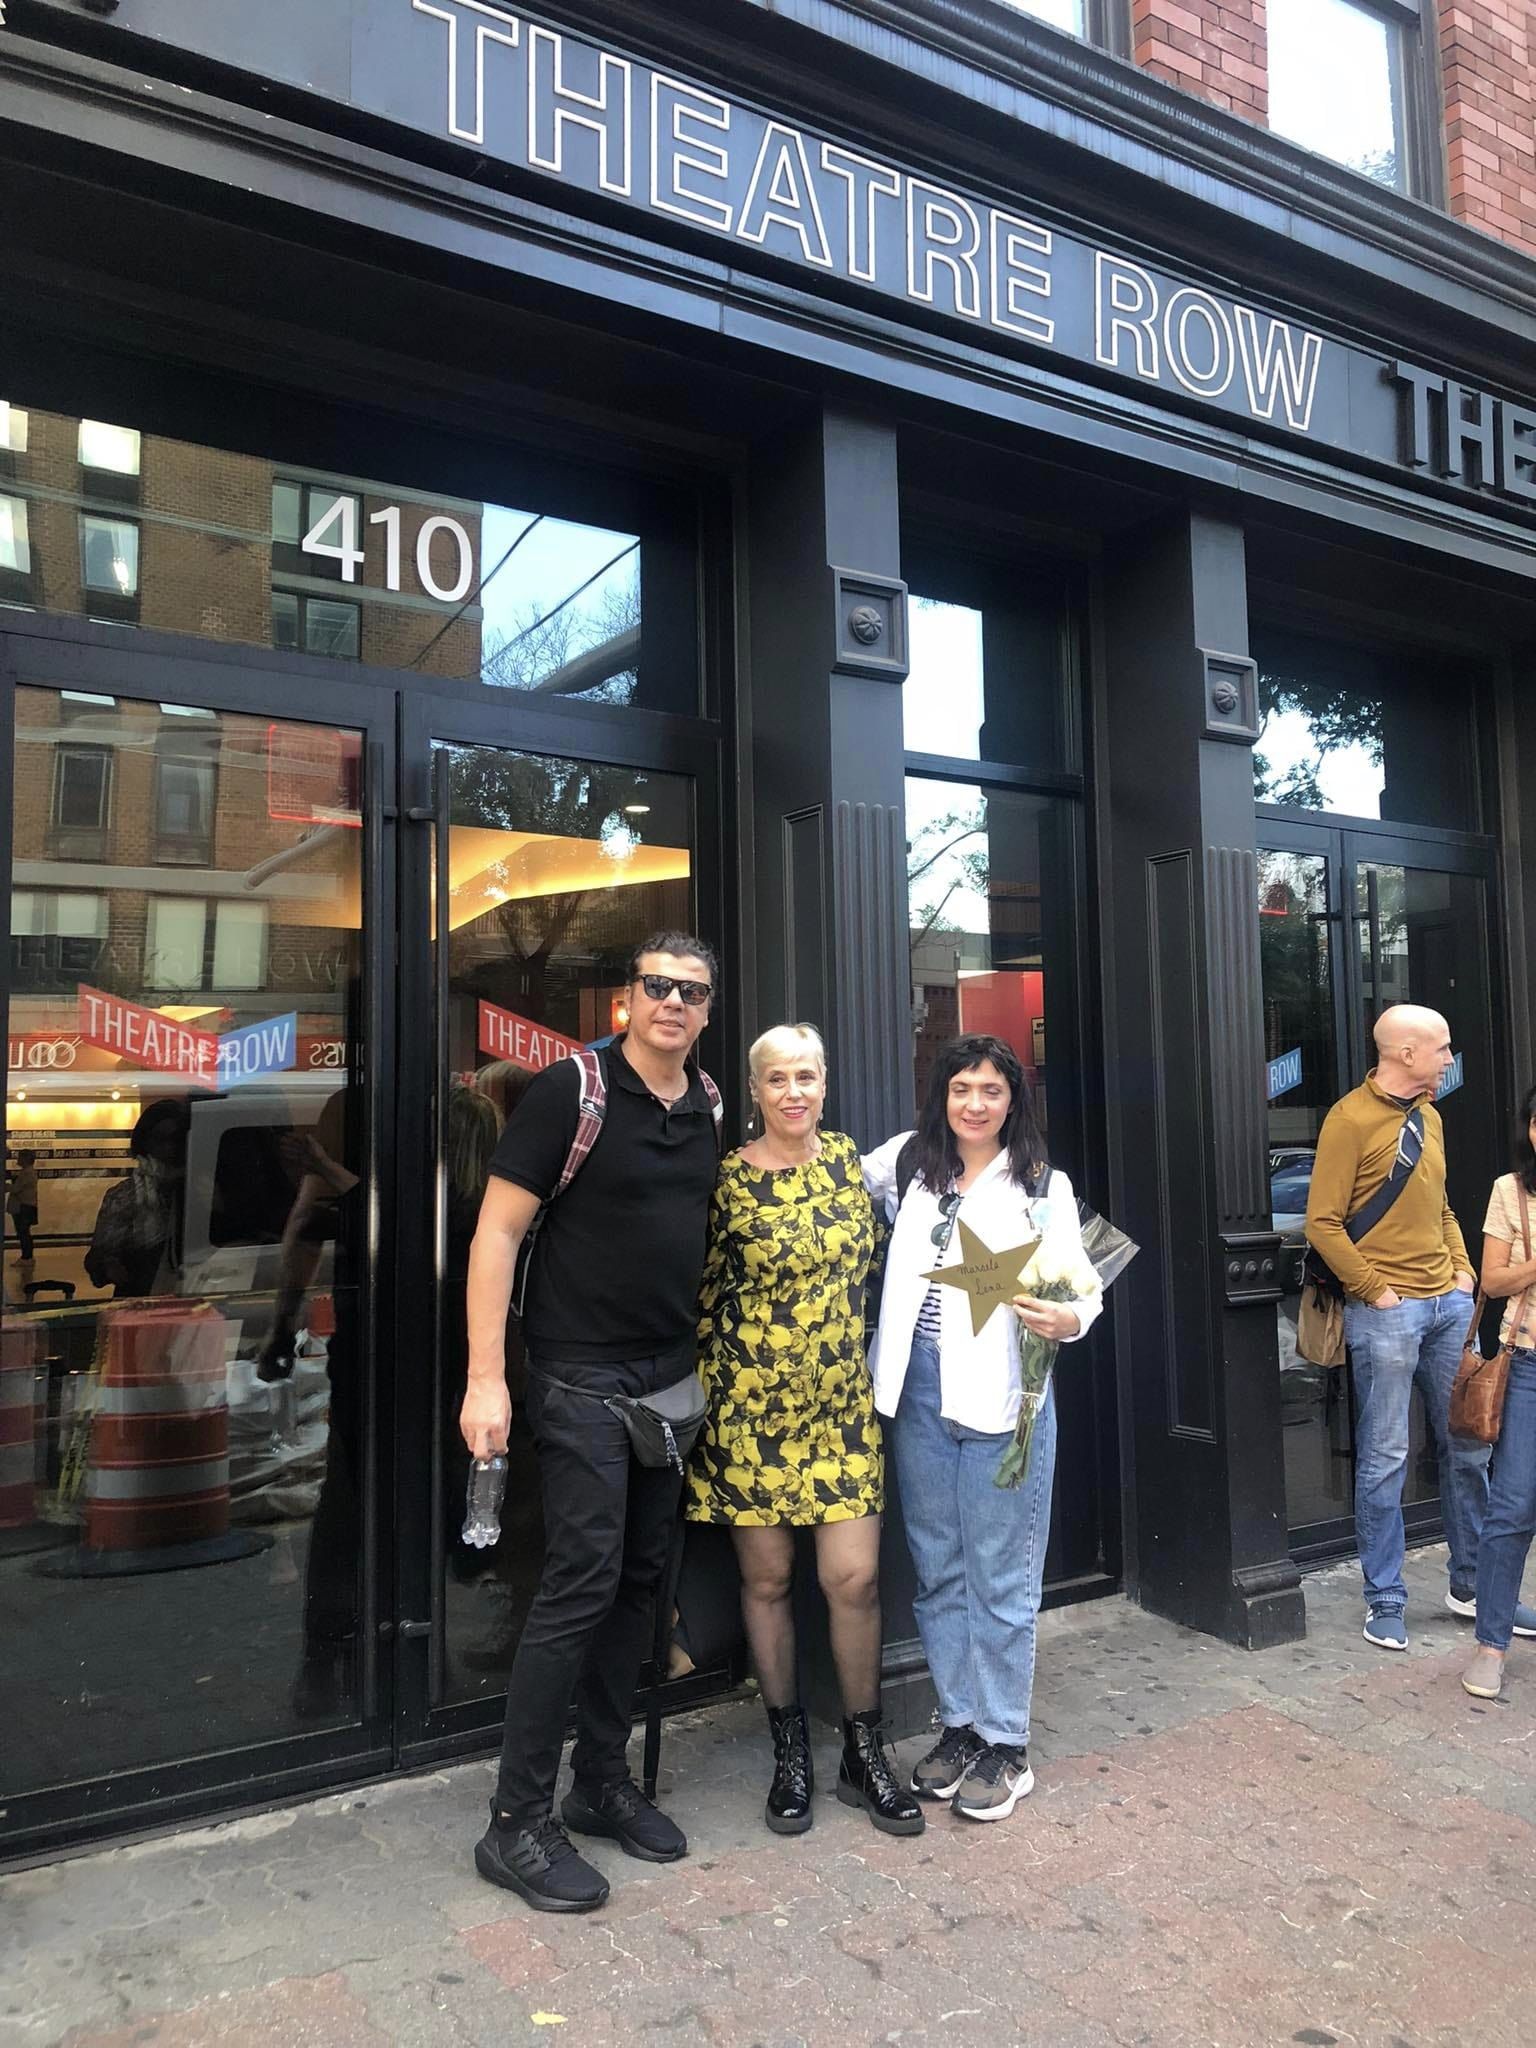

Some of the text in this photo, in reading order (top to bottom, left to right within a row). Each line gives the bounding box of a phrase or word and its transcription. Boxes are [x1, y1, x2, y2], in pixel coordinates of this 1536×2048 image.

[413, 0, 1323, 432] THEATRE ROW
[302, 495, 473, 602] 410
[85, 994, 212, 1082] THEATRE
[223, 1021, 291, 1082] ROW
[1269, 1053, 1299, 1093] ROW
[1437, 1058, 1461, 1095] OW
